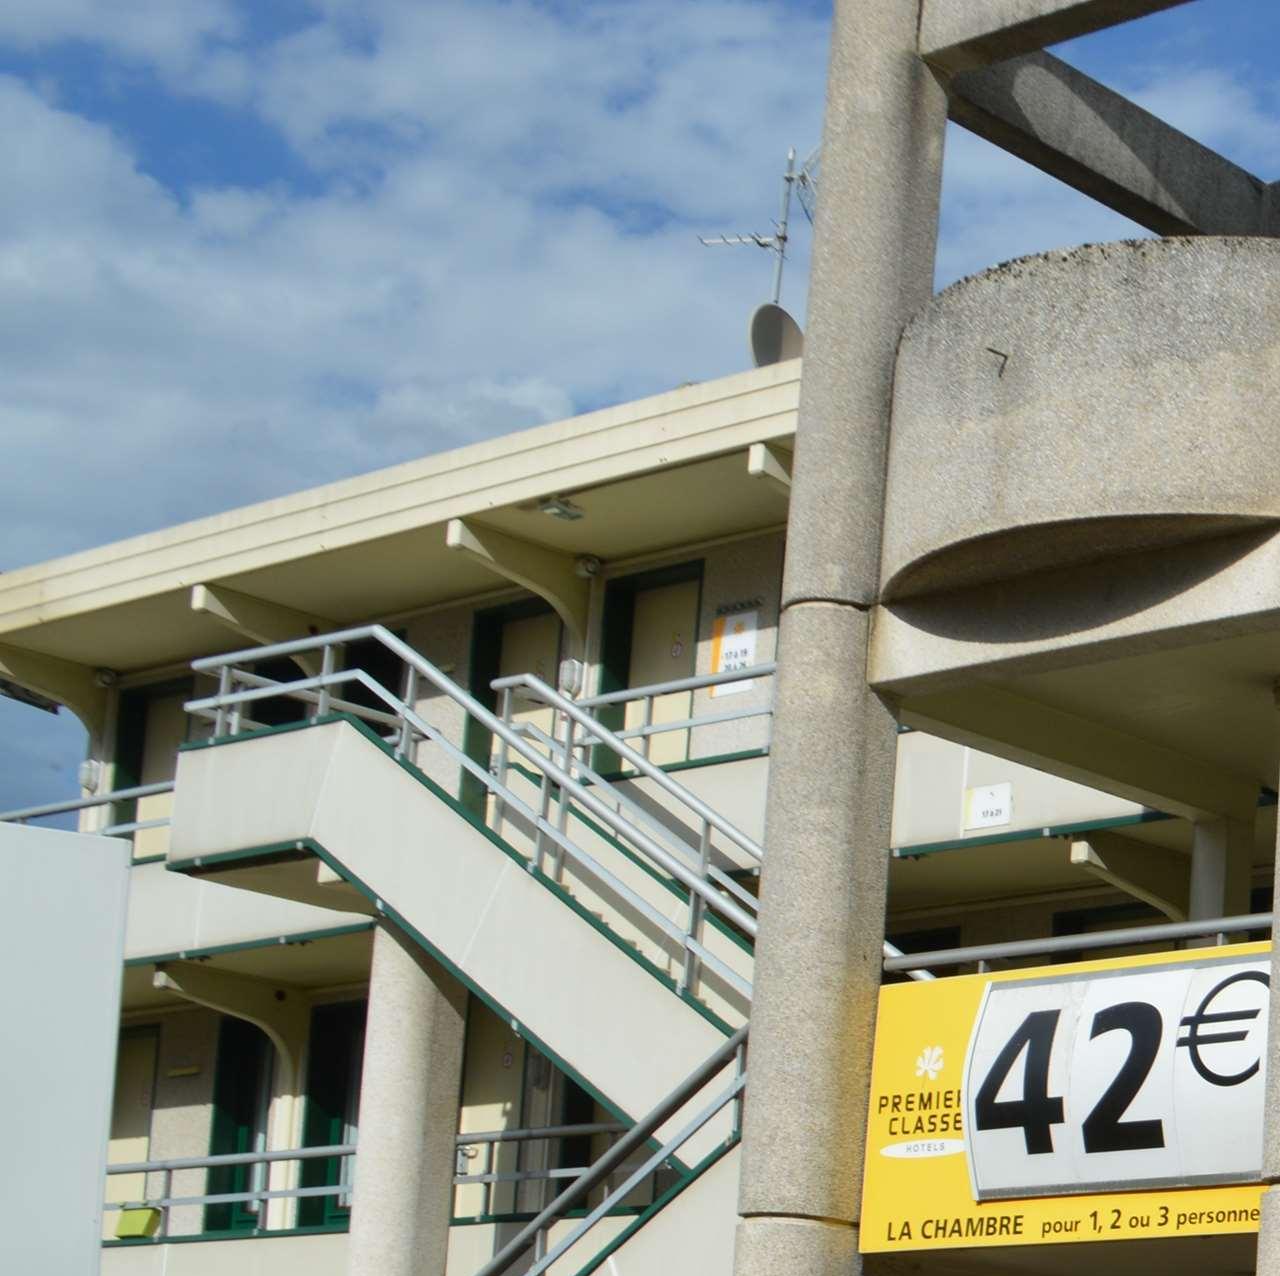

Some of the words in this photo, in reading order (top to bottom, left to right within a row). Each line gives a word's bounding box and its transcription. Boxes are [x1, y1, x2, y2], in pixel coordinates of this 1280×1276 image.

[889, 1112, 962, 1135] CLASSE
[906, 1142, 945, 1152] HOTELS
[887, 1221, 912, 1241] LA
[921, 1215, 1024, 1239] CHAMBRE
[1041, 1218, 1081, 1238] pour
[1089, 1210, 1103, 1233] 1,
[1110, 1208, 1122, 1229] 2
[1128, 1214, 1150, 1229] ou
[1157, 1206, 1169, 1227] 3
